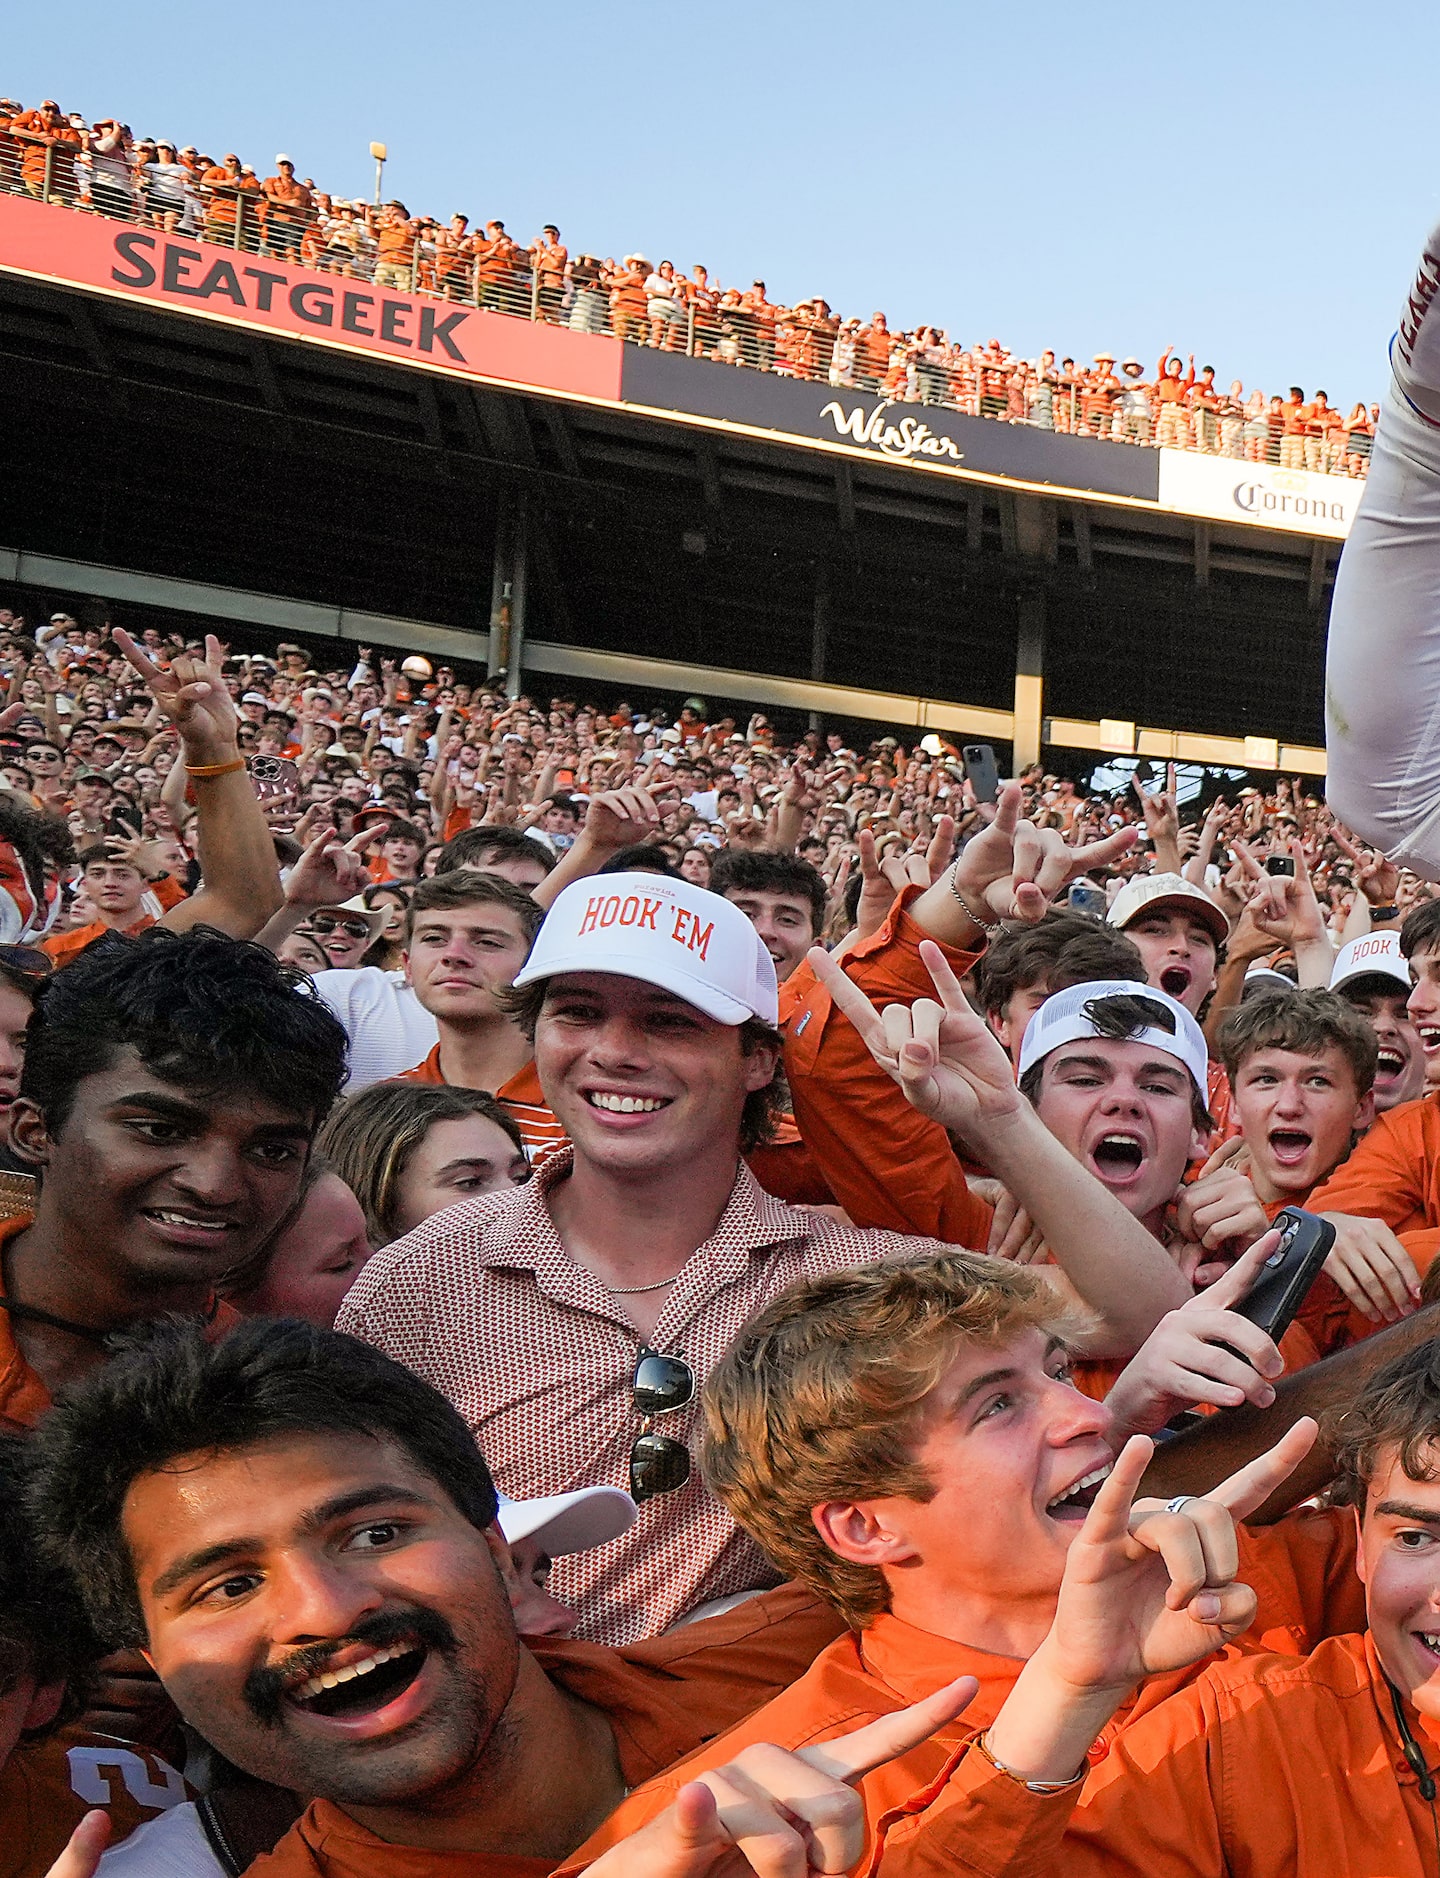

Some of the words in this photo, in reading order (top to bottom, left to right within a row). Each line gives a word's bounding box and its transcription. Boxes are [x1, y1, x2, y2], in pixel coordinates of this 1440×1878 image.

[111, 231, 471, 365] SEATGEEK
[819, 401, 965, 460] WinStar
[1233, 479, 1346, 522] Corona
[577, 895, 663, 937] HOOK
[669, 904, 715, 963] 'EM
[1350, 939, 1392, 966] HOOK
